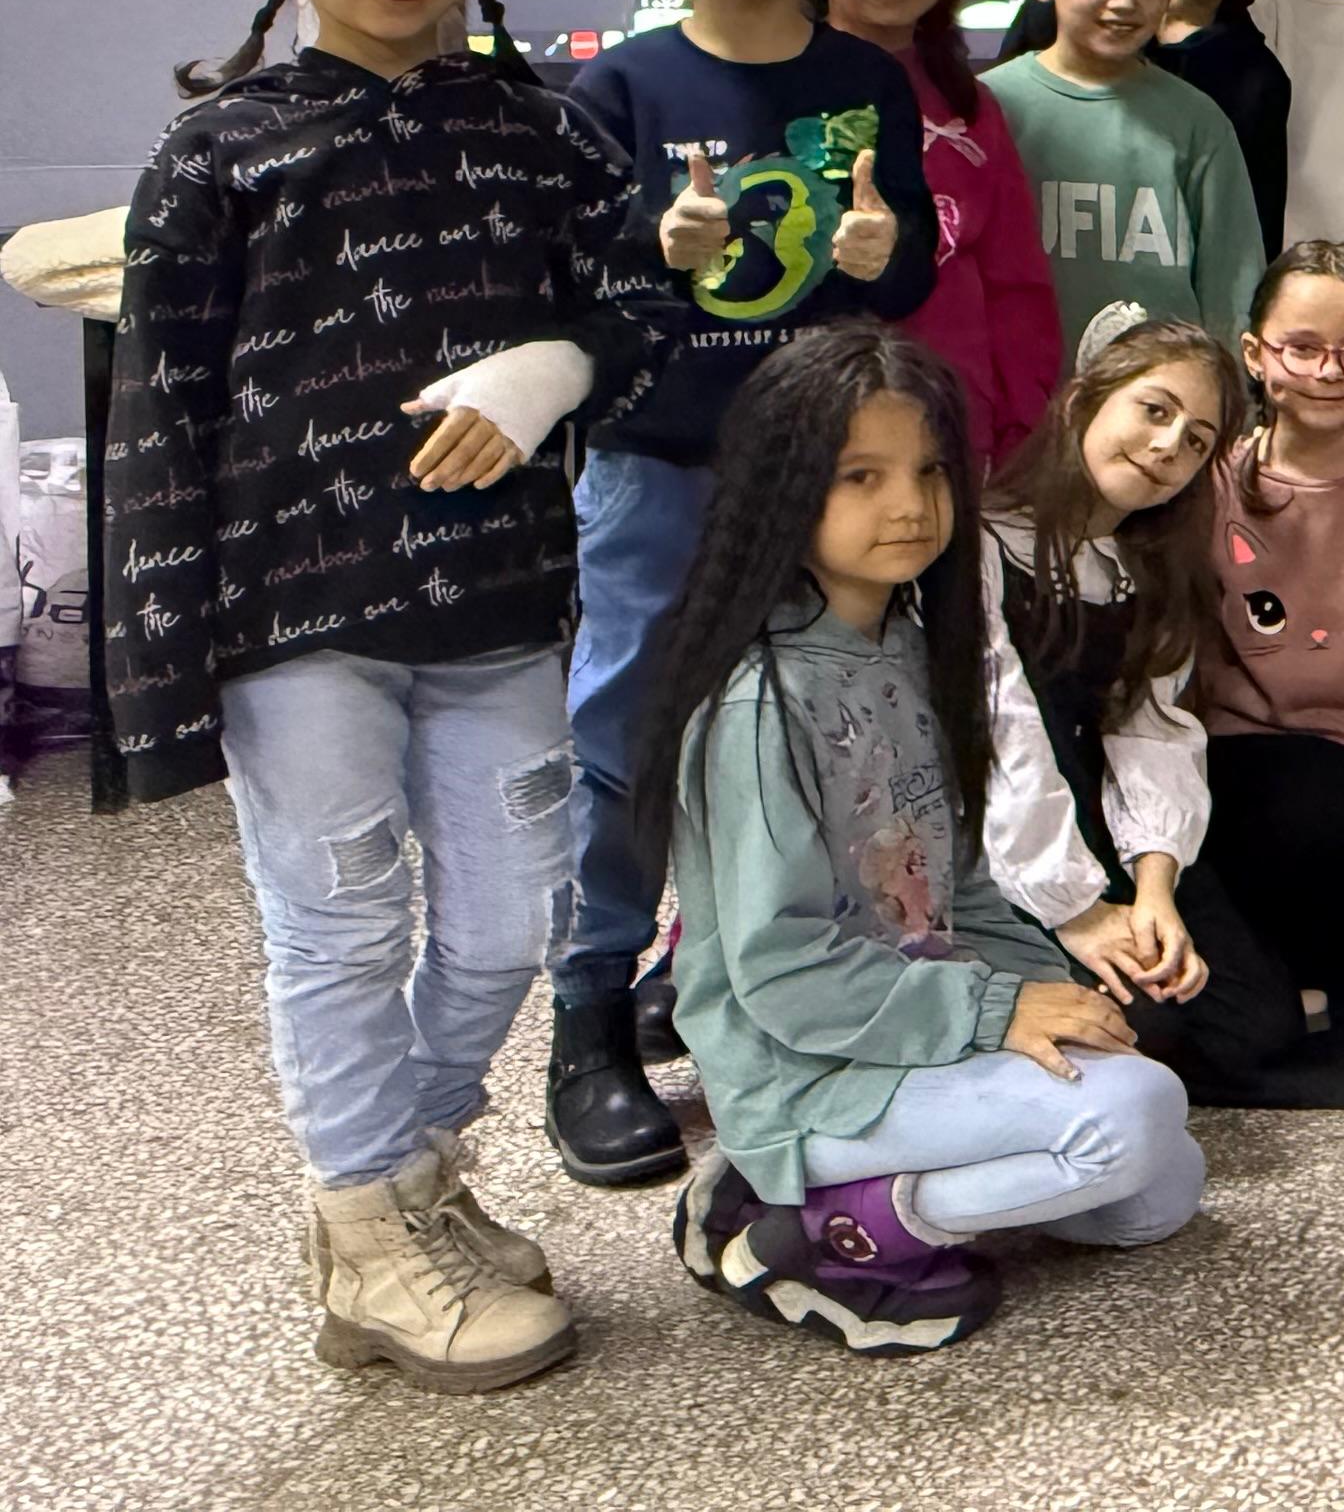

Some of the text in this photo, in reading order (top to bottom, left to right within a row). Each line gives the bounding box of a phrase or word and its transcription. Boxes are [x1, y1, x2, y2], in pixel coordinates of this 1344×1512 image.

[379, 102, 423, 143] the
[170, 151, 211, 185] the
[231, 147, 316, 192] dance
[454, 150, 528, 190] dance
[336, 228, 422, 272] dance
[482, 200, 524, 246] the
[363, 277, 412, 325] the
[232, 376, 280, 423] the
[298, 418, 394, 463] dance
[323, 468, 374, 517] the
[122, 538, 204, 584] dance
[136, 591, 182, 641] the
[419, 566, 465, 607] the
